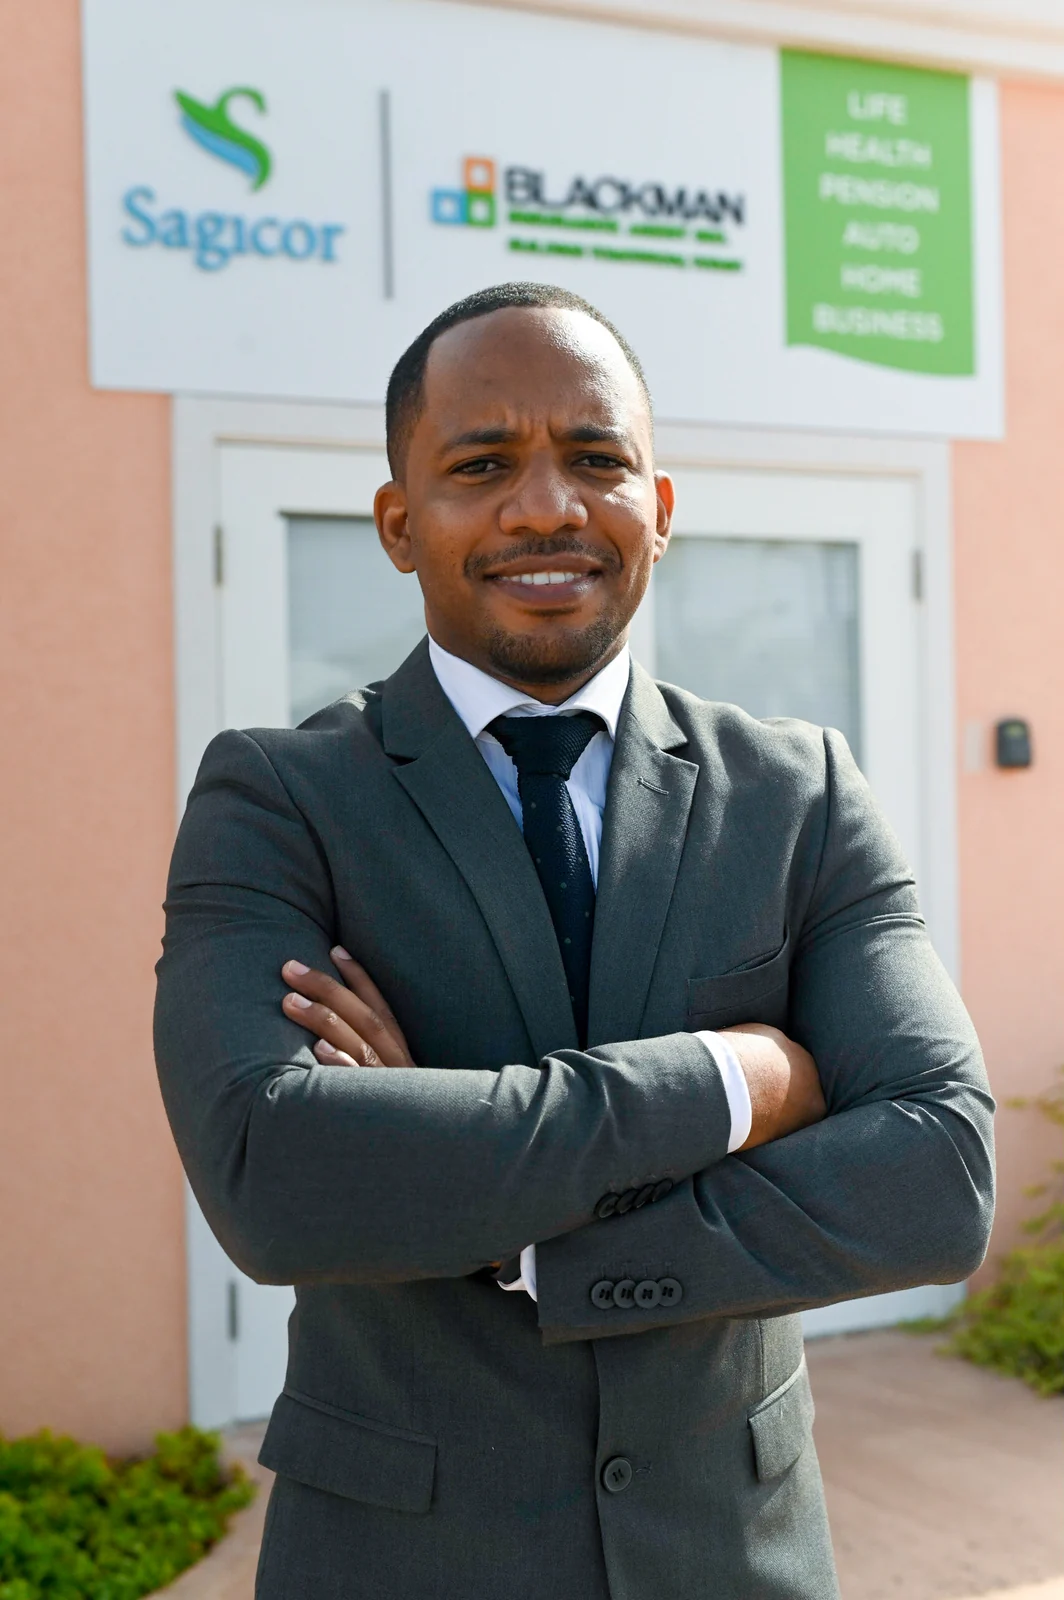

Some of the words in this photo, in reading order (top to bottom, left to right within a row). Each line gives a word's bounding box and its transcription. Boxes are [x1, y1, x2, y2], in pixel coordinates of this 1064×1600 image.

[847, 90, 908, 125] LIFE
[825, 131, 932, 170] HEALTH
[505, 165, 745, 225] BLACKMAN
[818, 173, 940, 213] PENSION
[122, 185, 345, 271] Sagicor
[843, 220, 920, 255] AUTO
[841, 263, 922, 298] HOME
[813, 303, 944, 343] BUSINESS
